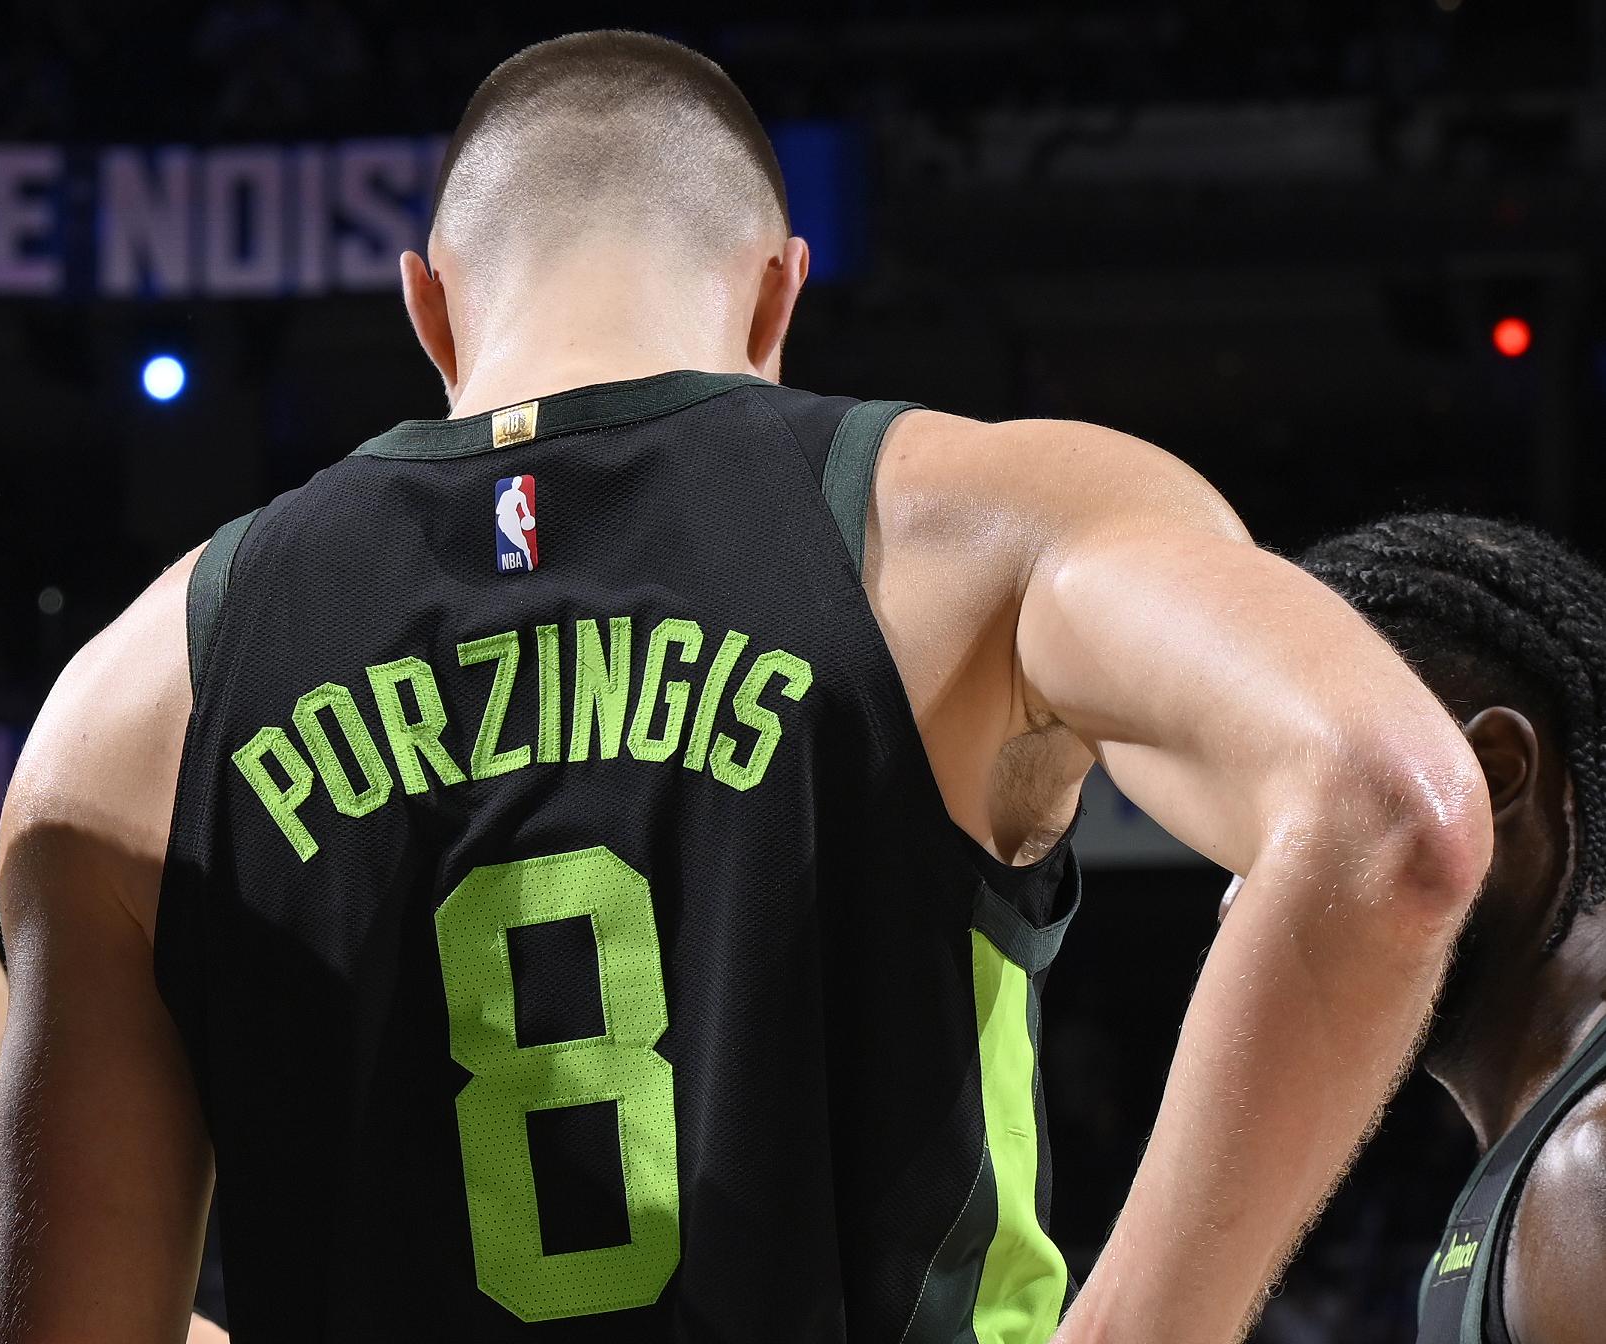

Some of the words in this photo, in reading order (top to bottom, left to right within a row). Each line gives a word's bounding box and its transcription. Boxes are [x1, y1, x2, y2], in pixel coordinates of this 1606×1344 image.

[99, 135, 460, 295] NOIS
[501, 551, 523, 571] NBA
[231, 616, 814, 863] PORZINGIS
[434, 845, 681, 1323] 8
